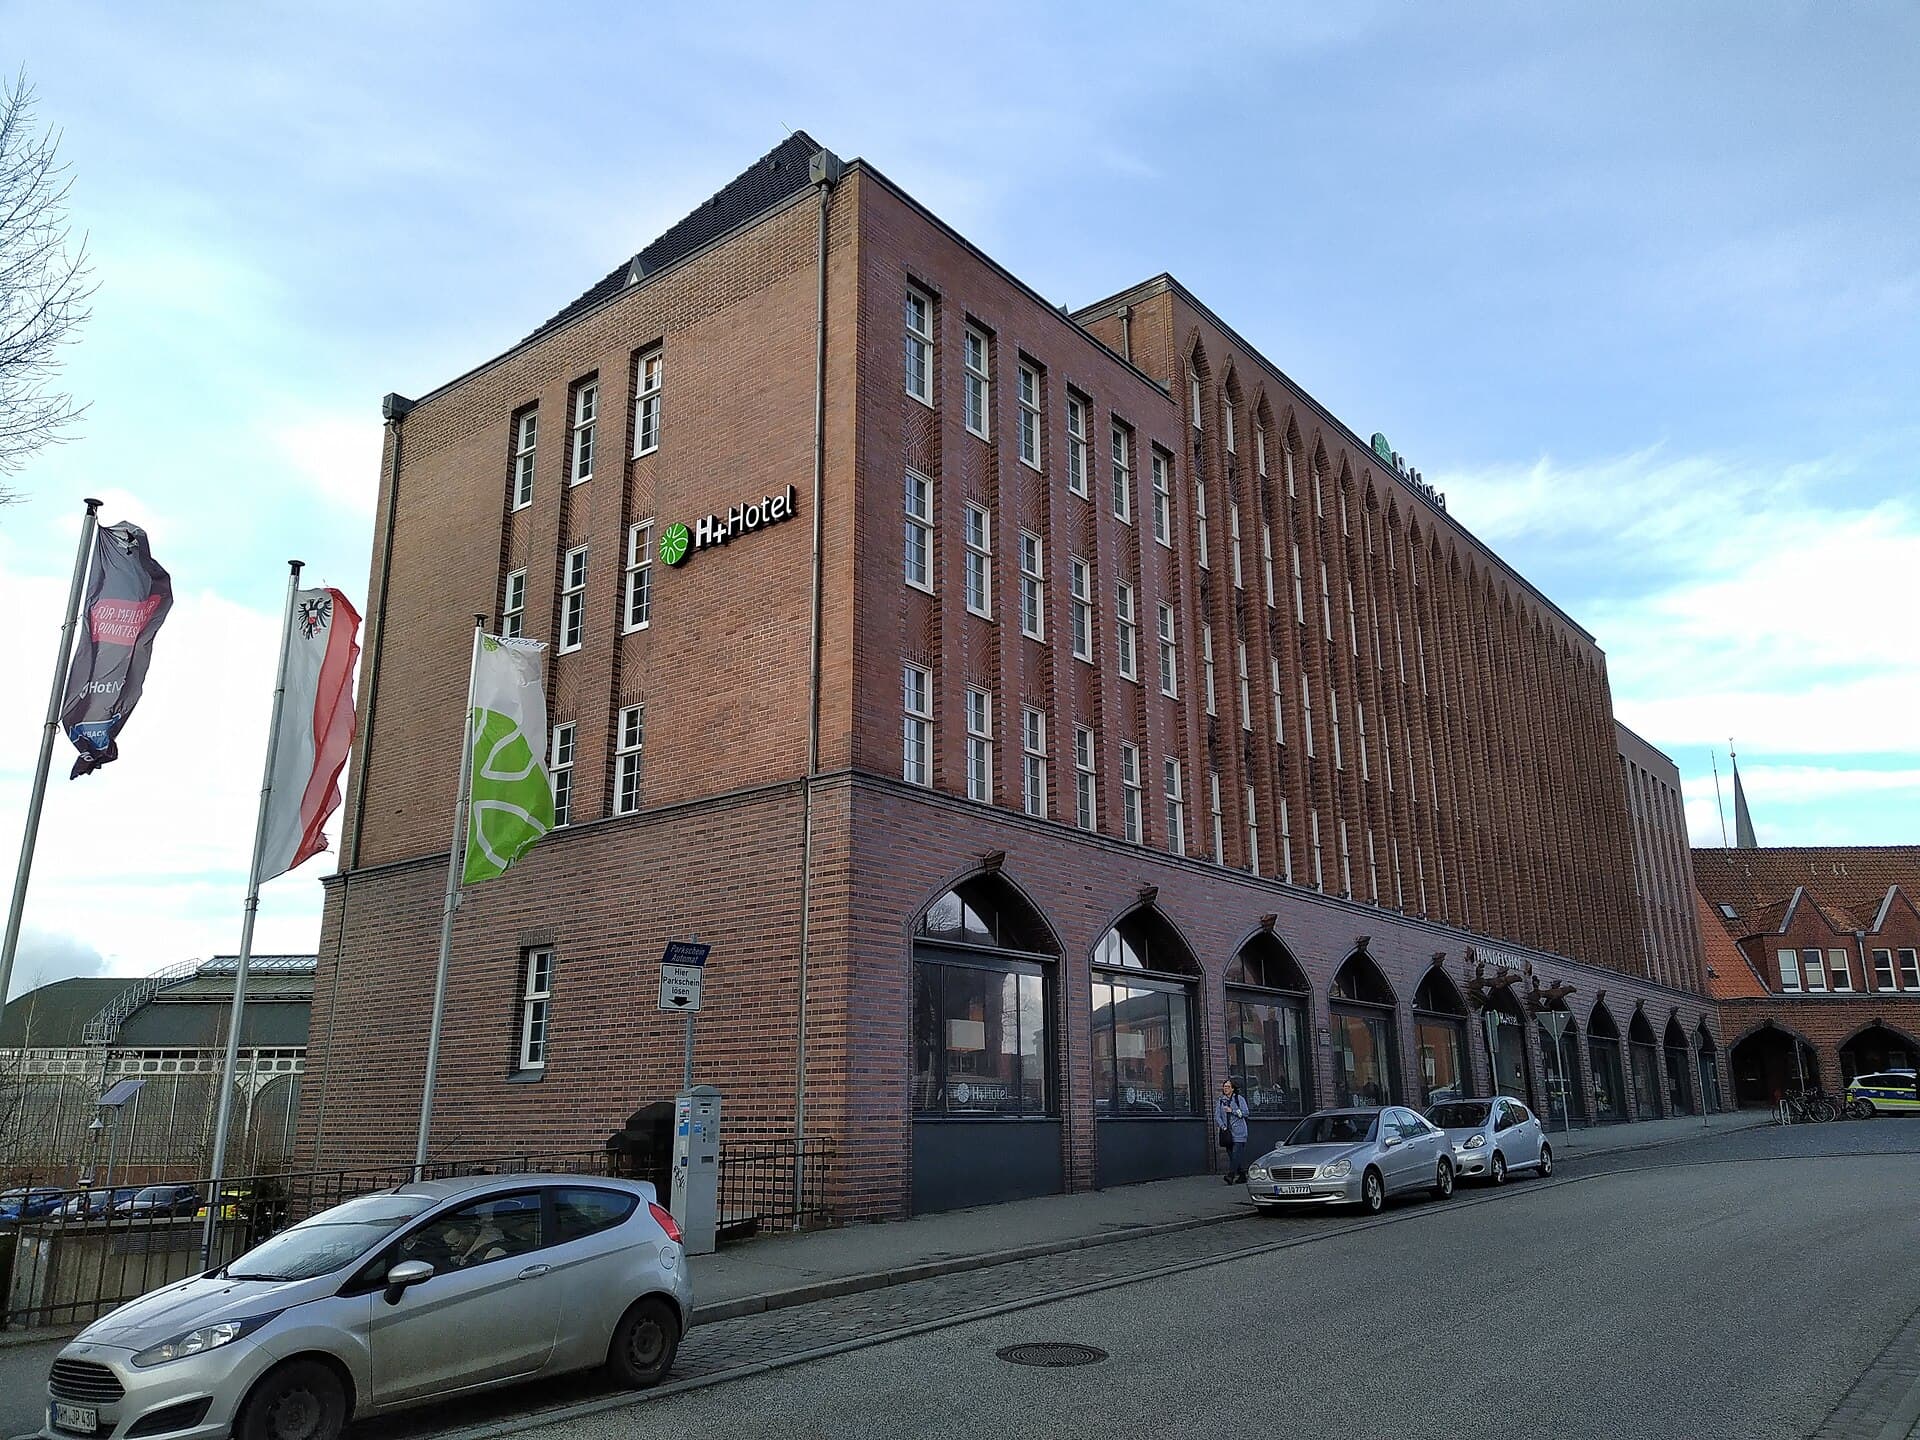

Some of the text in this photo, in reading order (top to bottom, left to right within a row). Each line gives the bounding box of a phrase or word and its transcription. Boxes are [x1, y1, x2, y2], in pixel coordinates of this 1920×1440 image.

[695, 484, 797, 547] H+Hotel
[670, 944, 706, 956] Parkschein
[674, 967, 689, 977] Hier
[663, 976, 700, 987] Parkschein
[671, 986, 690, 996] lösen
